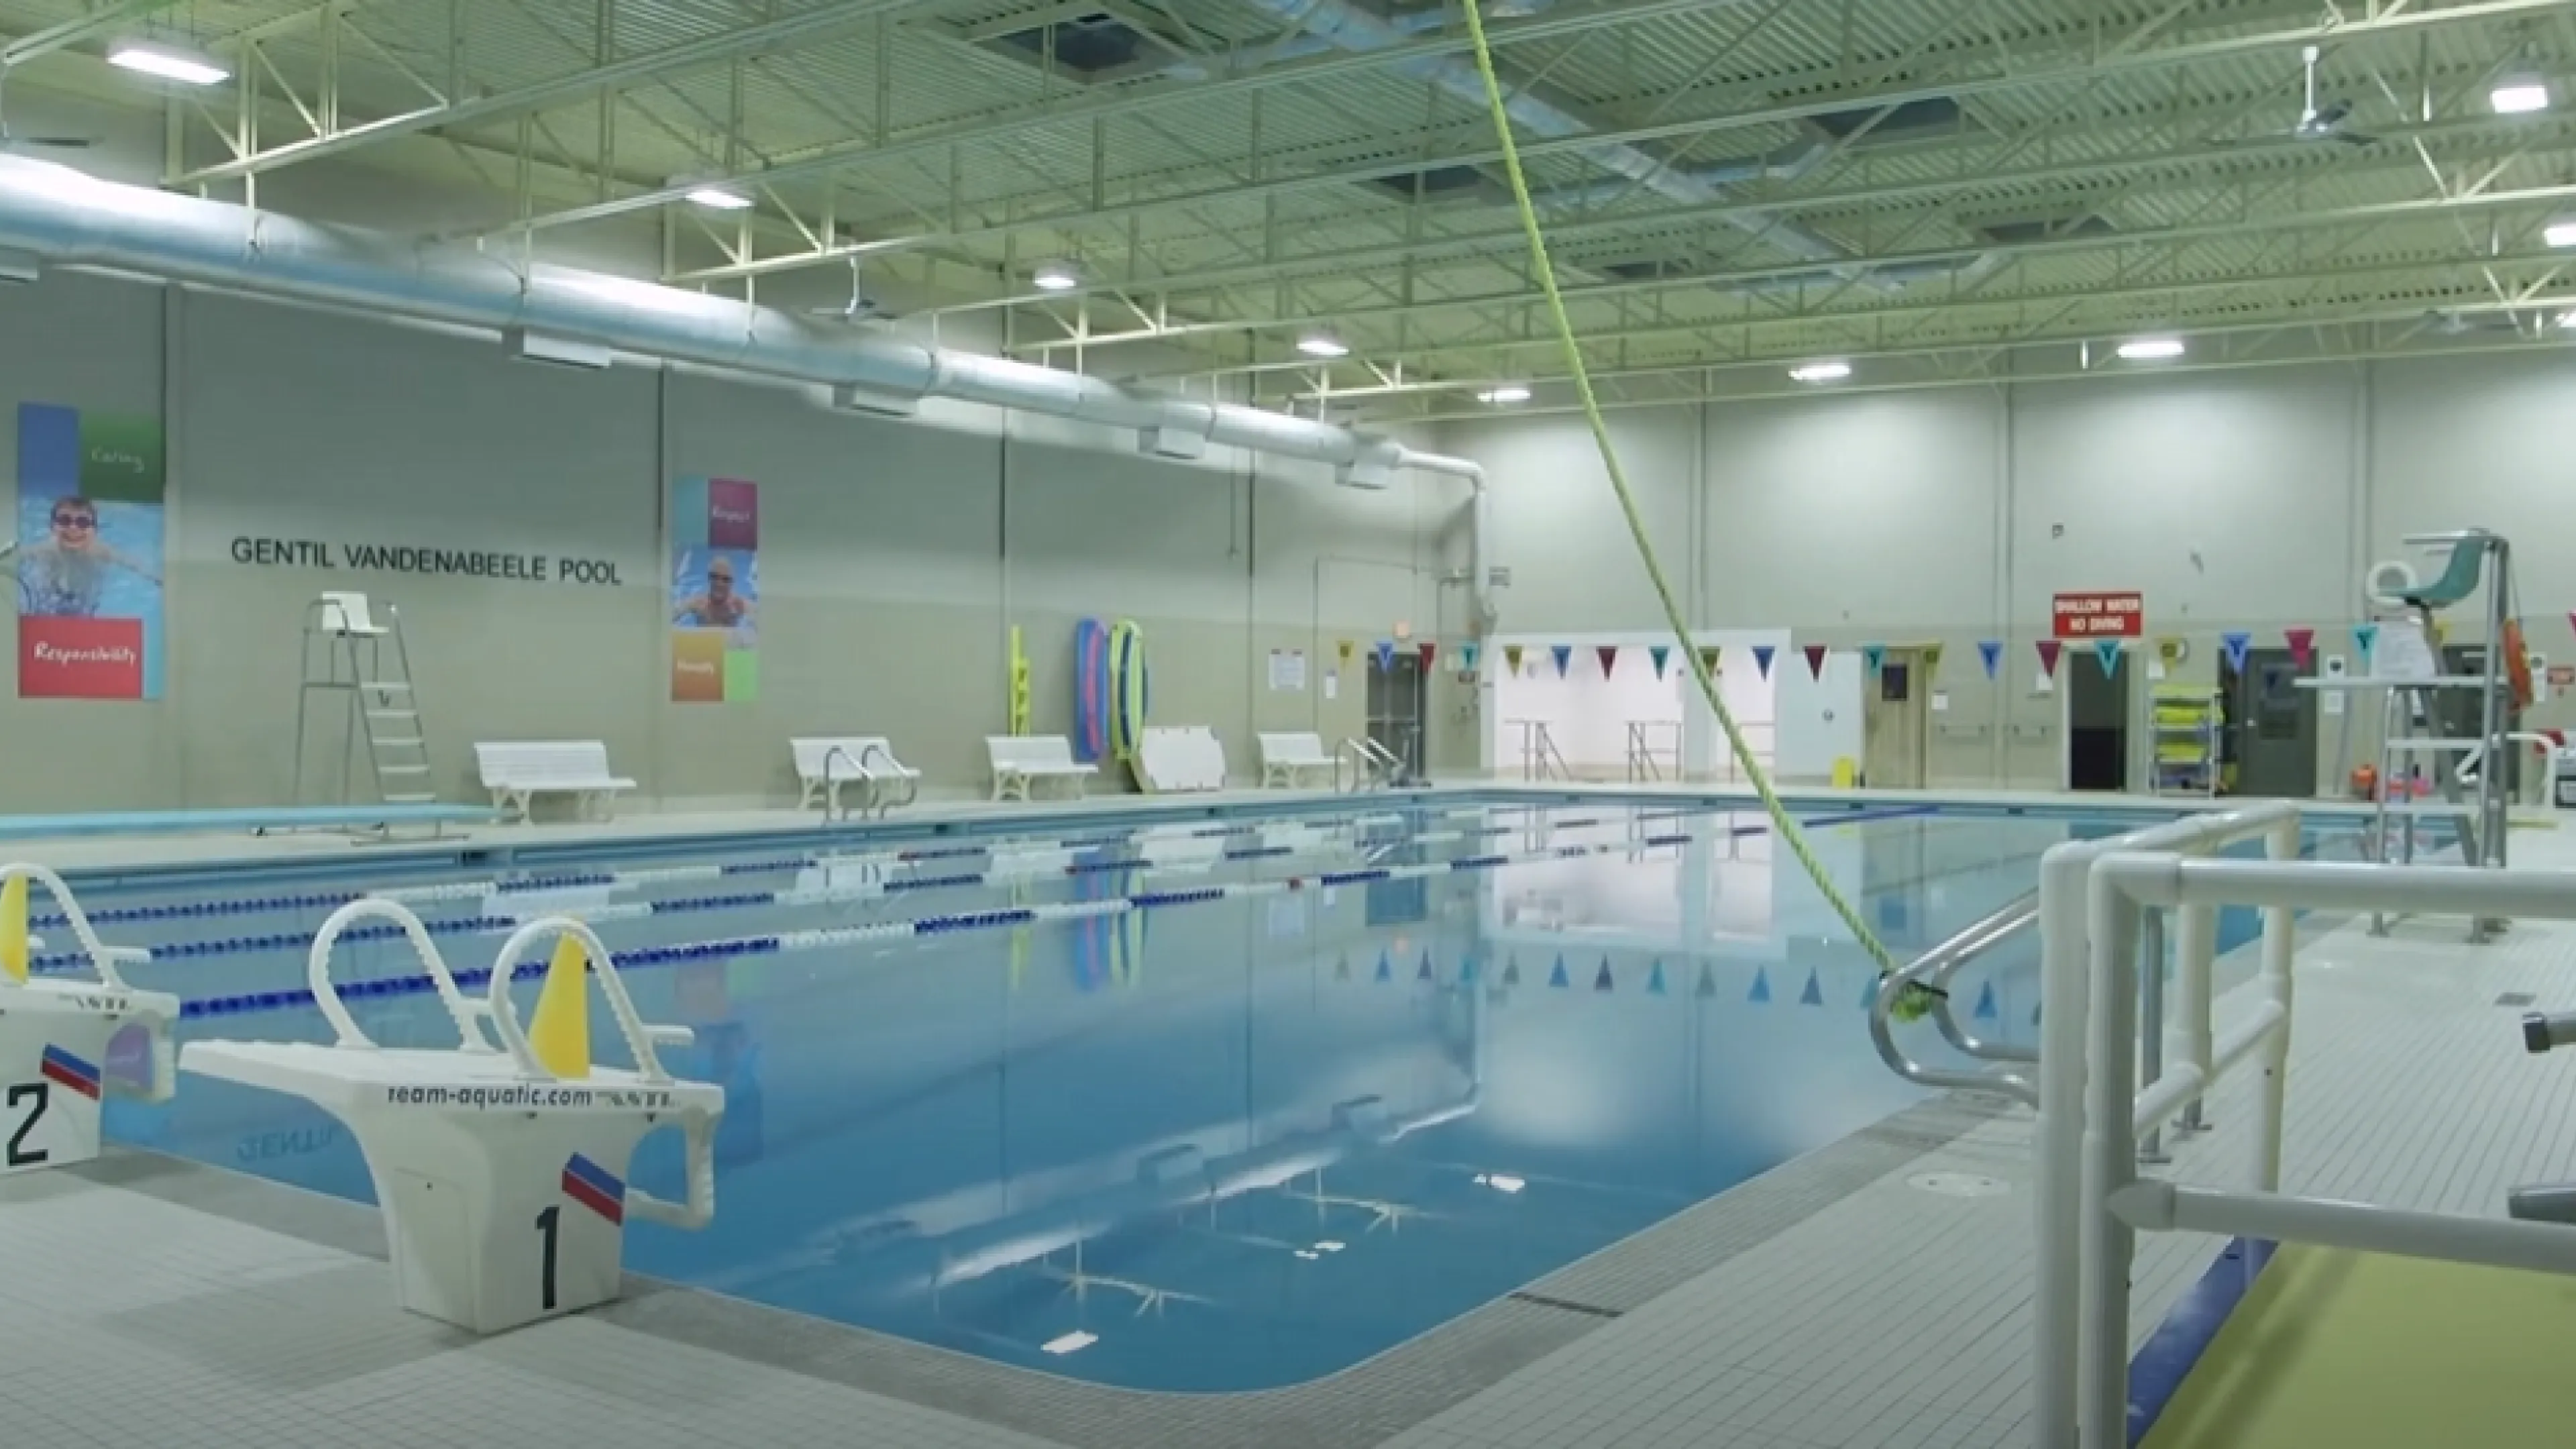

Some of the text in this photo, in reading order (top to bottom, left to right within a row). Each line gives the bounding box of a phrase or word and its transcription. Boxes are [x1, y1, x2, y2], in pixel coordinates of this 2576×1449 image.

[231, 536, 622, 586] GENTIL VANDENABEELE POOL
[2068, 615, 2125, 633] NO DIVING
[34, 640, 137, 668] Responsibility
[7, 1083, 49, 1167] 2
[535, 1205, 559, 1309] 1
